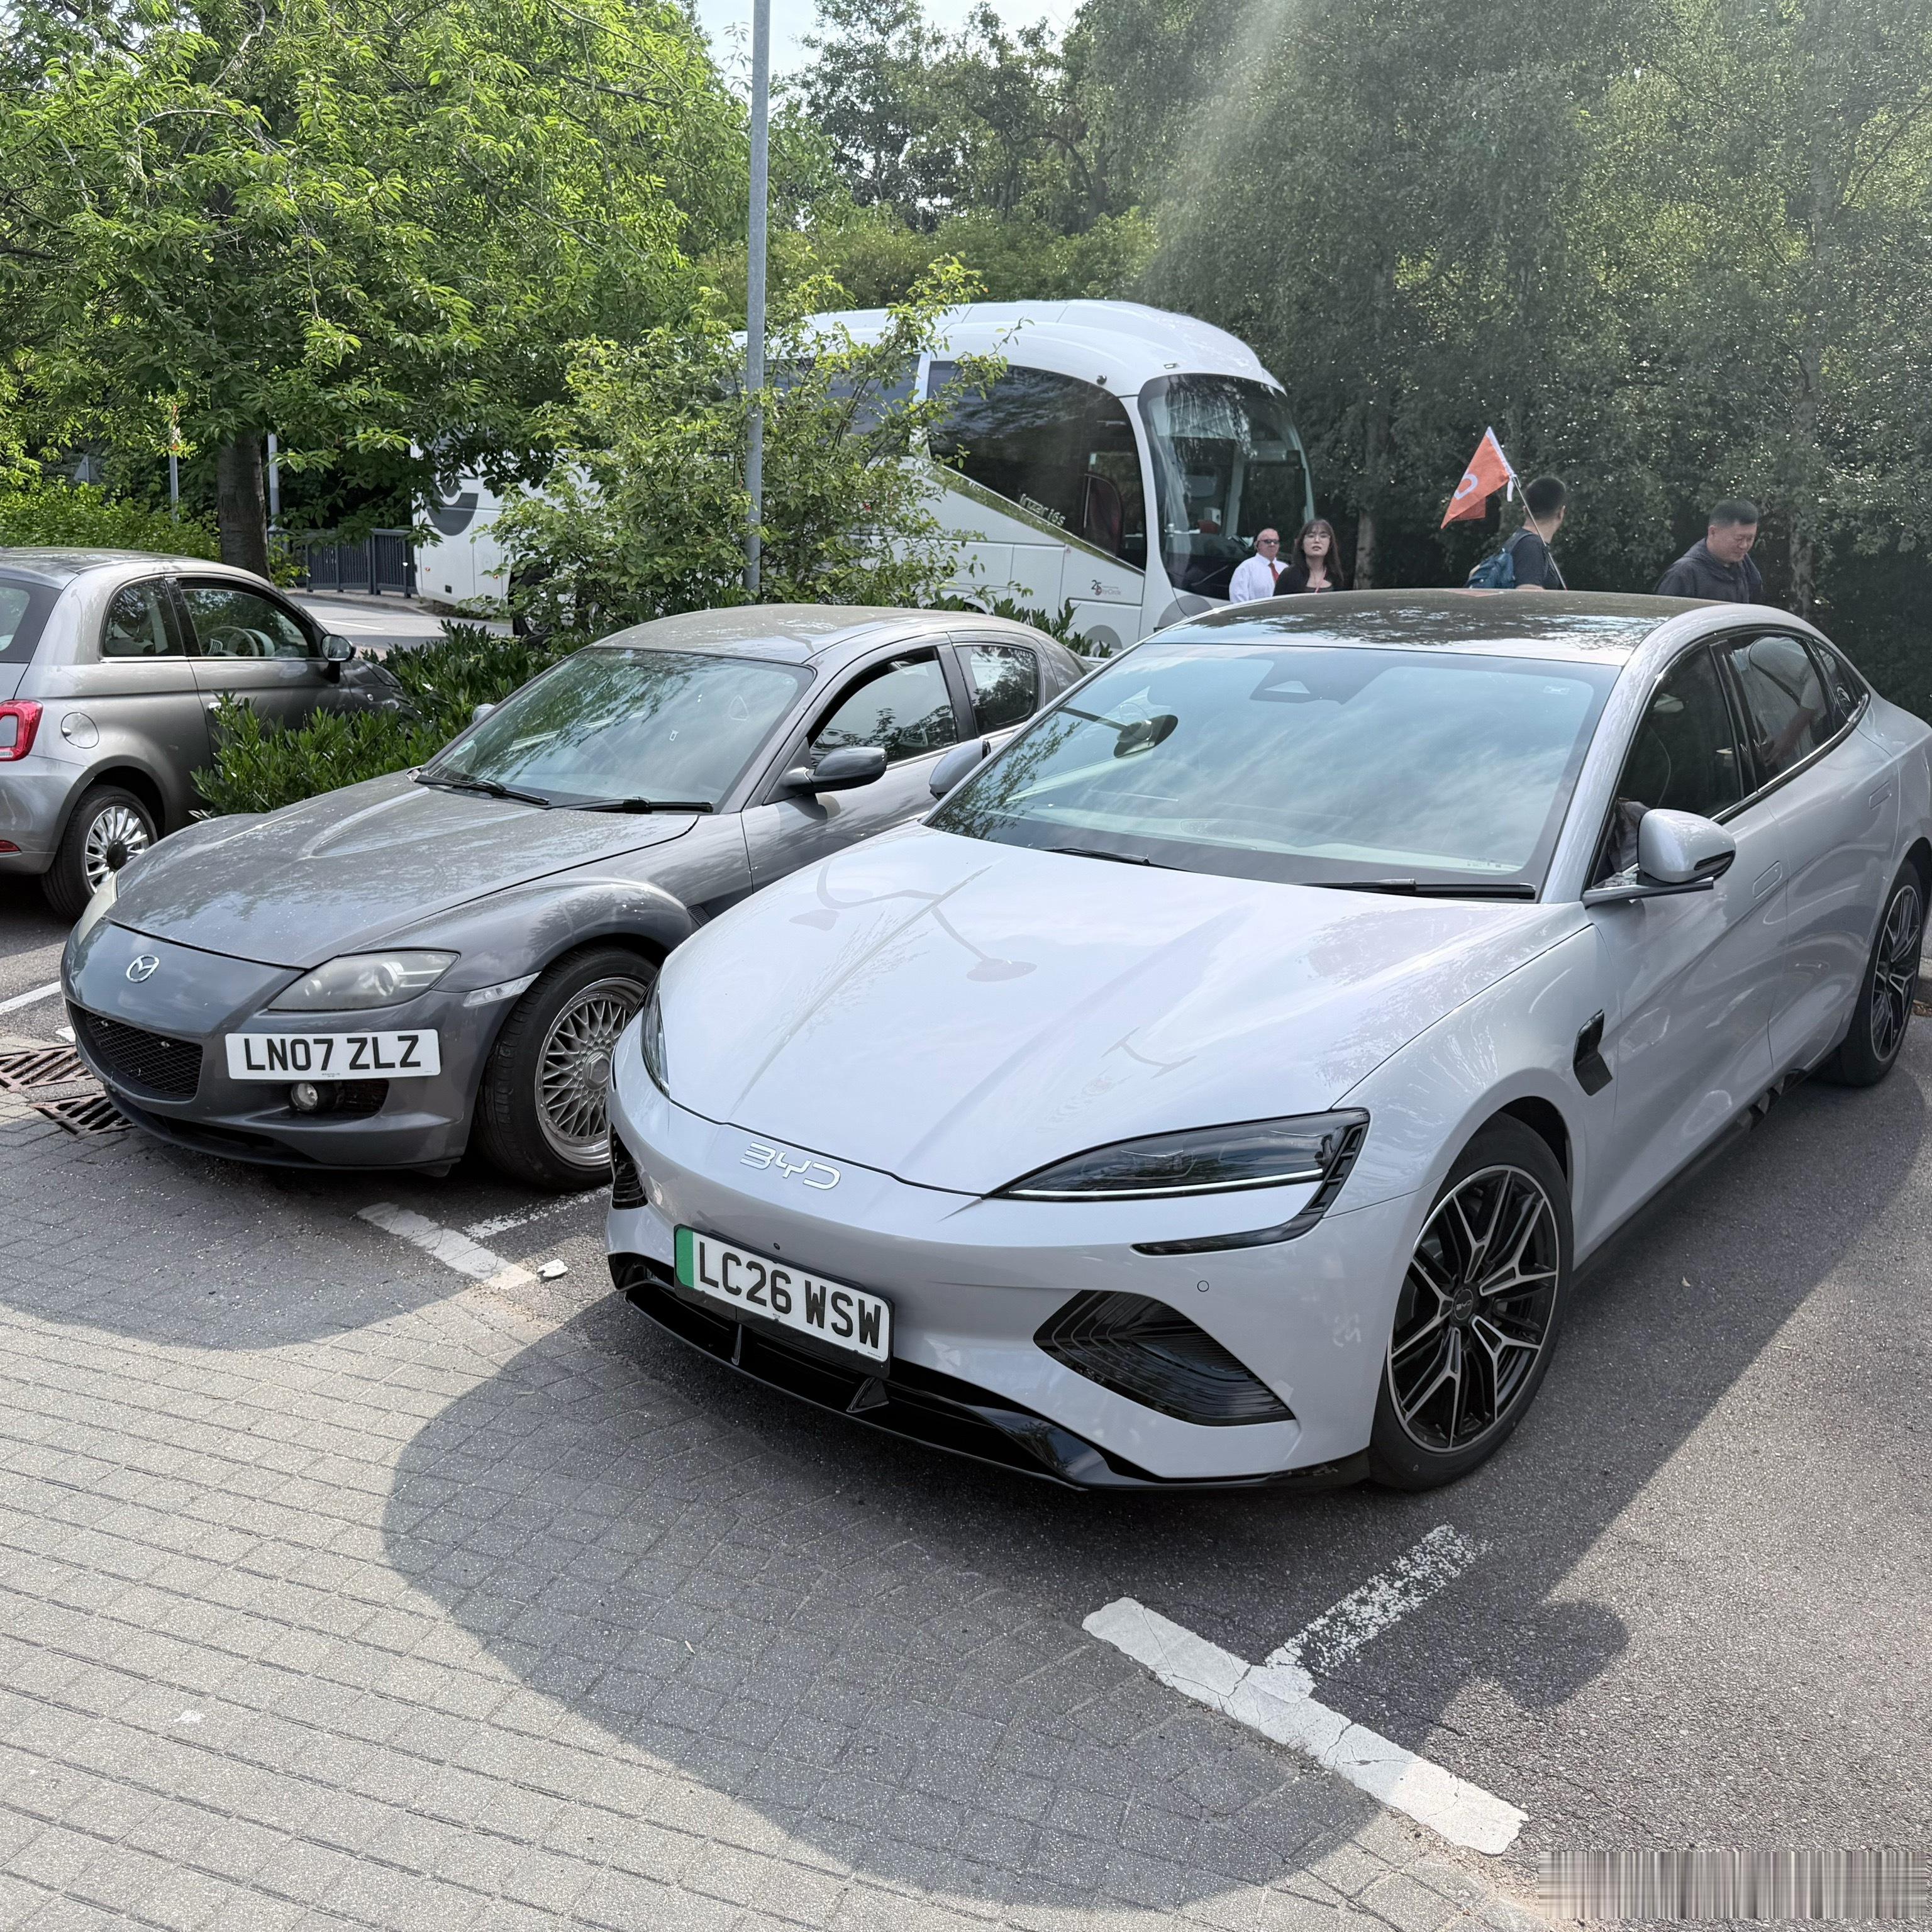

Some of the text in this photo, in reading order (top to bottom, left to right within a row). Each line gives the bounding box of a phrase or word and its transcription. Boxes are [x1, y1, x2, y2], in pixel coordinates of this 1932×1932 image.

[243, 1035, 421, 1071] LN07 ZLZ
[740, 1141, 841, 1191] BYD
[699, 1241, 882, 1350] LC26 WSW
